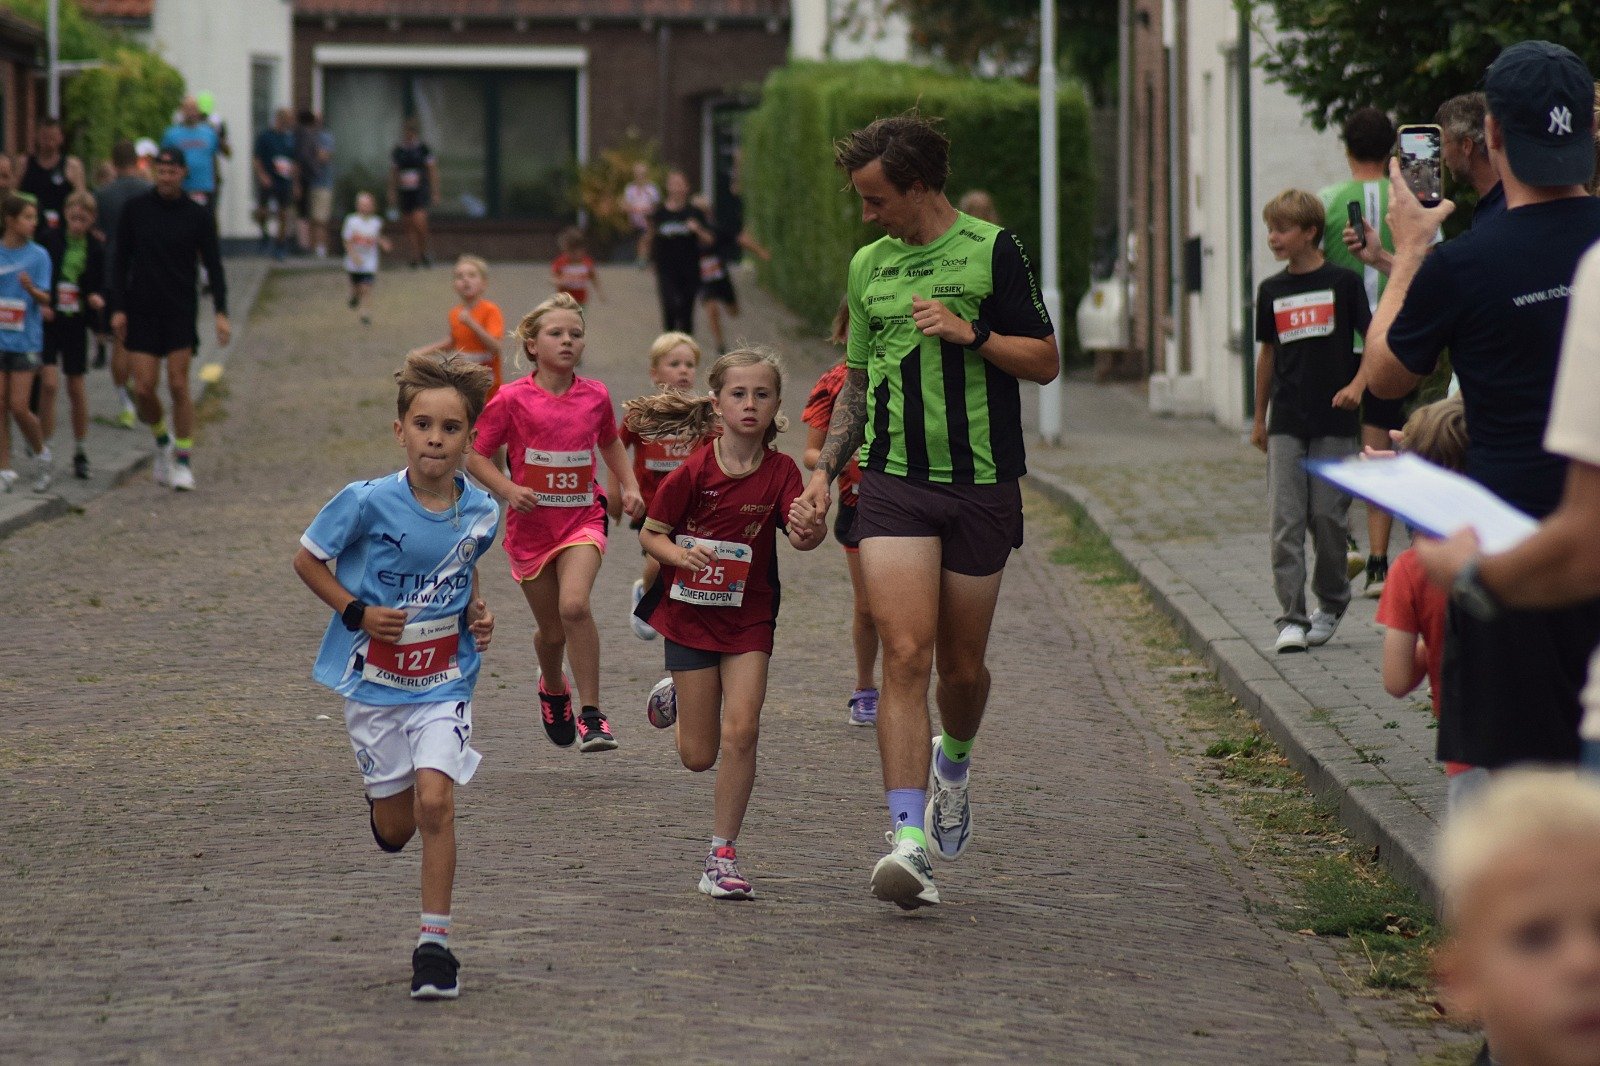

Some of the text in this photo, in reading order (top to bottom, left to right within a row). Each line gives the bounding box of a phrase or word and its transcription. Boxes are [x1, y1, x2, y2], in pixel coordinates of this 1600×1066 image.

[1027, 271, 1049, 325] RUNNERS
[1290, 309, 1316, 327] 511
[545, 472, 578, 489] 133
[534, 493, 587, 503] OMERLOPEN
[377, 570, 469, 590] ETIHAD
[396, 592, 455, 605] AIRWAYS
[394, 647, 437, 672] 127
[375, 668, 449, 688] ZOMERLOPEN
